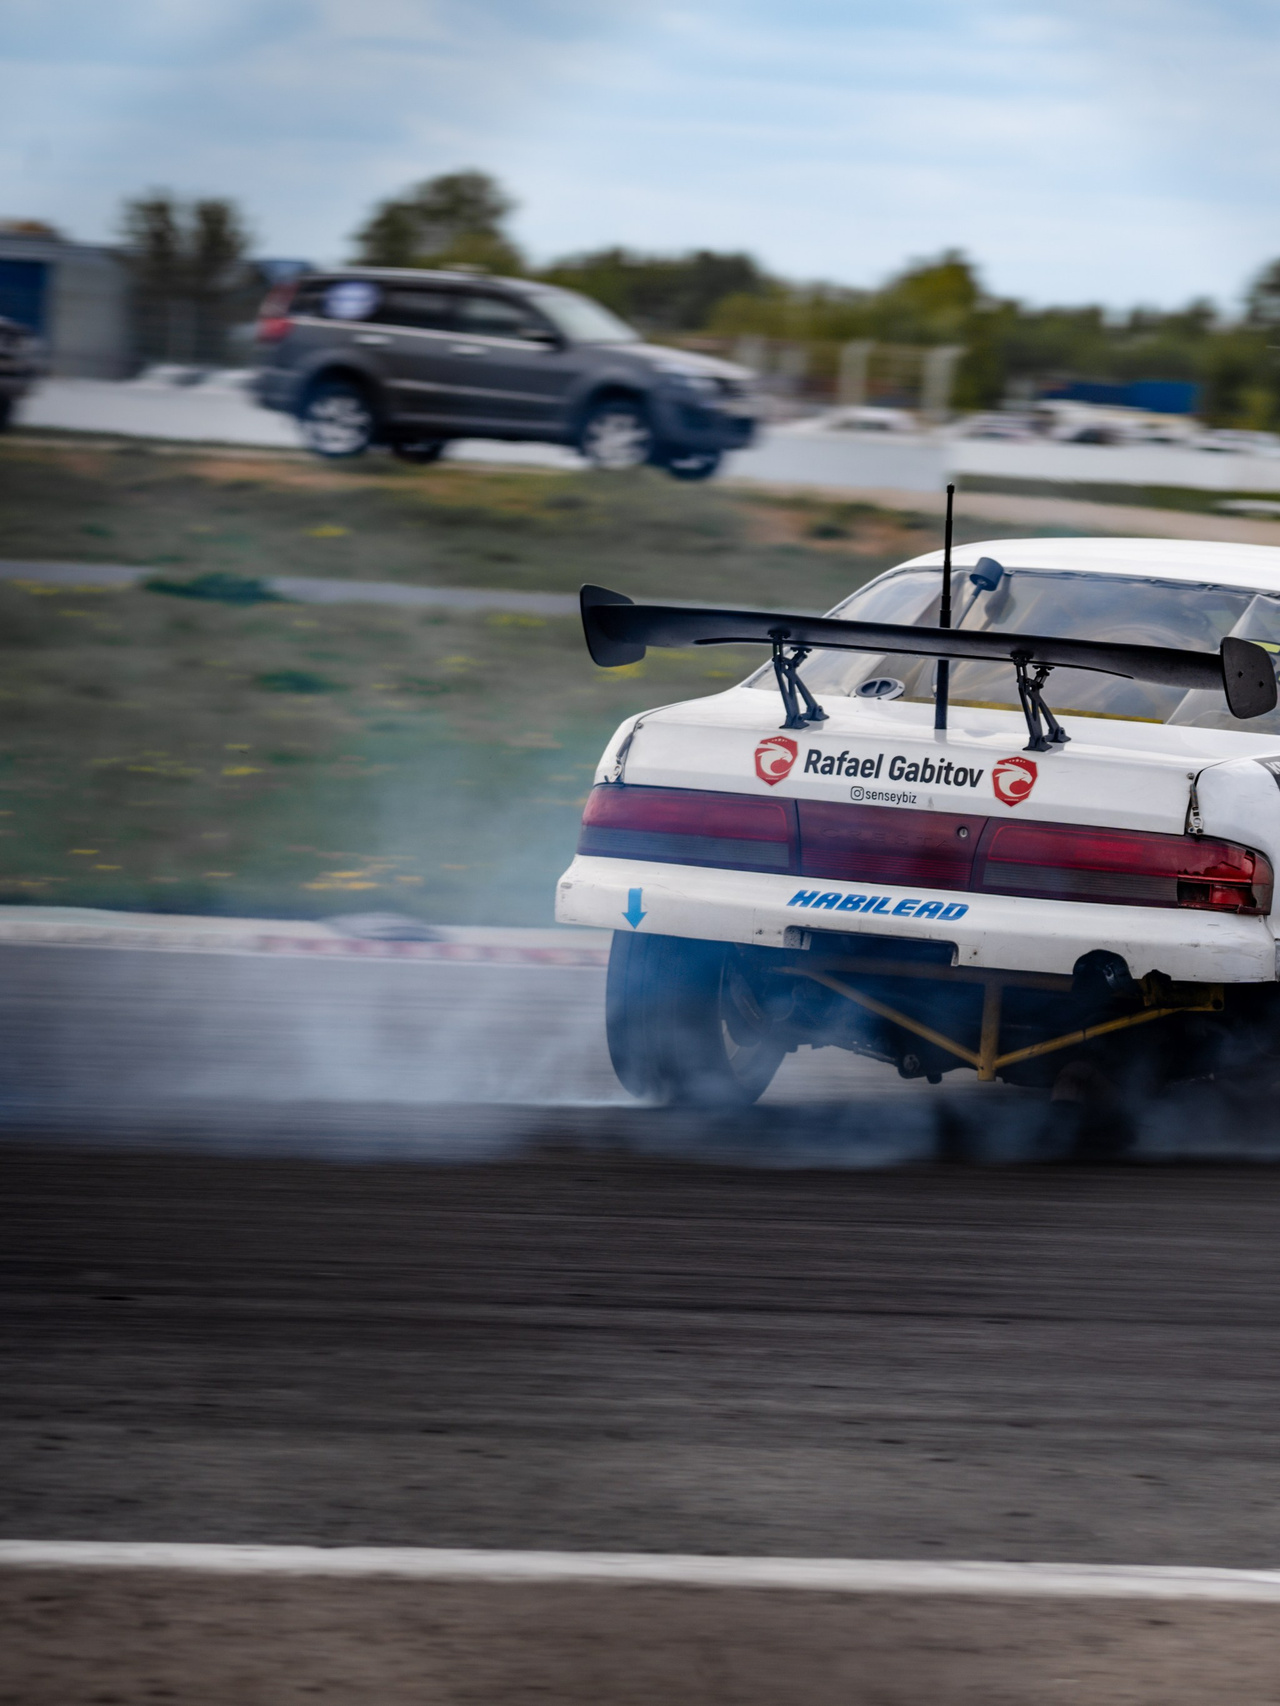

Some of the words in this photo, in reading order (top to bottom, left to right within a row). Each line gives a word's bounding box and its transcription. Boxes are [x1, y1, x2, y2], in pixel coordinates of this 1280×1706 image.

[803, 748, 884, 778] Rafael
[888, 755, 984, 788] Gabitov
[865, 789, 917, 804] senseybiz
[819, 827, 954, 849] CRESTA
[786, 889, 970, 921] HABILEAD
